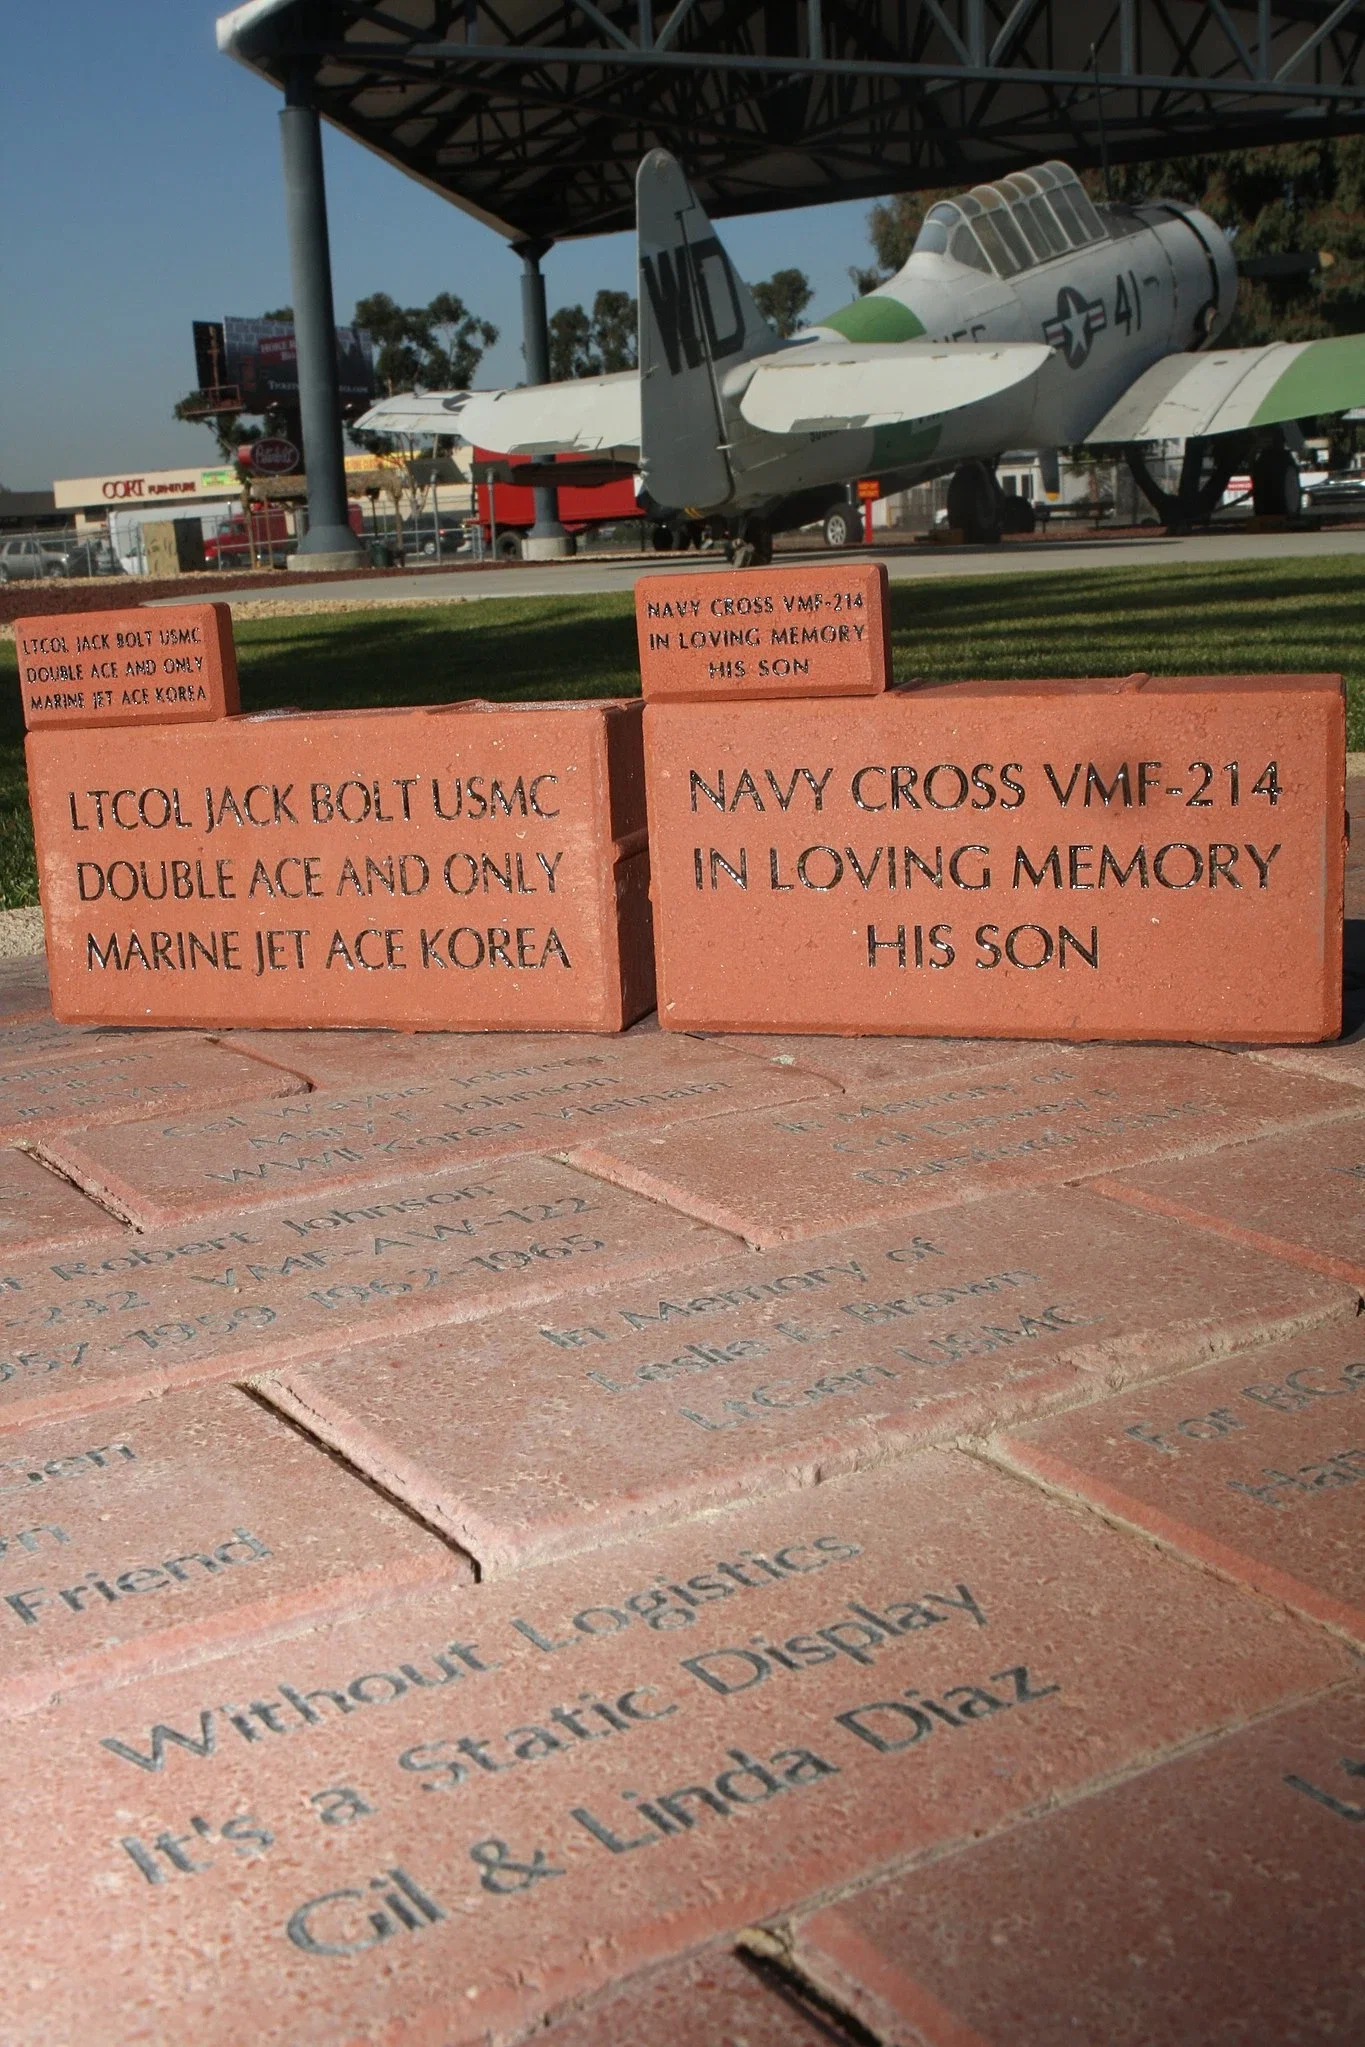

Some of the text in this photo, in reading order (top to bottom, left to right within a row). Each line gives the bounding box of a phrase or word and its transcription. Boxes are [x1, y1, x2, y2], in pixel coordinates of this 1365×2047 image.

[640, 237, 746, 376] WD
[102, 479, 196, 499] CORT FURNITURE
[647, 592, 863, 618] NAVY CROSS VMF-214
[23, 627, 201, 655] LTCOL JACK BOLT USMC
[650, 624, 865, 650] IN LOVING MEMORY
[26, 656, 203, 684] DOUBLE ACE AND ONLY
[708, 658, 809, 679] HIS SON
[31, 685, 207, 710] MARINE JET ACE KOREA
[69, 774, 561, 833] LTCOL JACK BOLT USMC
[688, 760, 1284, 813] NAVY CROSS VMF-214
[76, 851, 564, 902] DOUBLE ACE AND ONLY
[694, 842, 1283, 892] IN LOVING MEMORY
[86, 927, 573, 977] MARINE JET ACE KOREA
[867, 923, 1100, 970] HIS SON
[162, 1054, 621, 1138] Col Wayne Johnson
[248, 1119, 376, 1149] Mary
[443, 1075, 621, 1115] Johnson
[833, 1083, 1018, 1122] Memory
[1030, 1067, 1077, 1085] of
[204, 1079, 732, 1183] WWII Korea Vietnam
[50, 1183, 496, 1281] Robert Johnson
[303, 1233, 605, 1309] 1962-1965
[537, 1236, 946, 1350] In Memory of
[584, 1338, 771, 1394] Leslie
[839, 1269, 1042, 1325] Brown
[892, 1304, 1105, 1368] USMC
[1124, 1406, 1248, 1457] For
[4, 1526, 274, 1625] Friend
[101, 1532, 865, 1773] Without Logistics
[118, 1582, 989, 1885] It's a Static Display
[285, 1663, 1062, 1957] Gil & Linda Diaz
